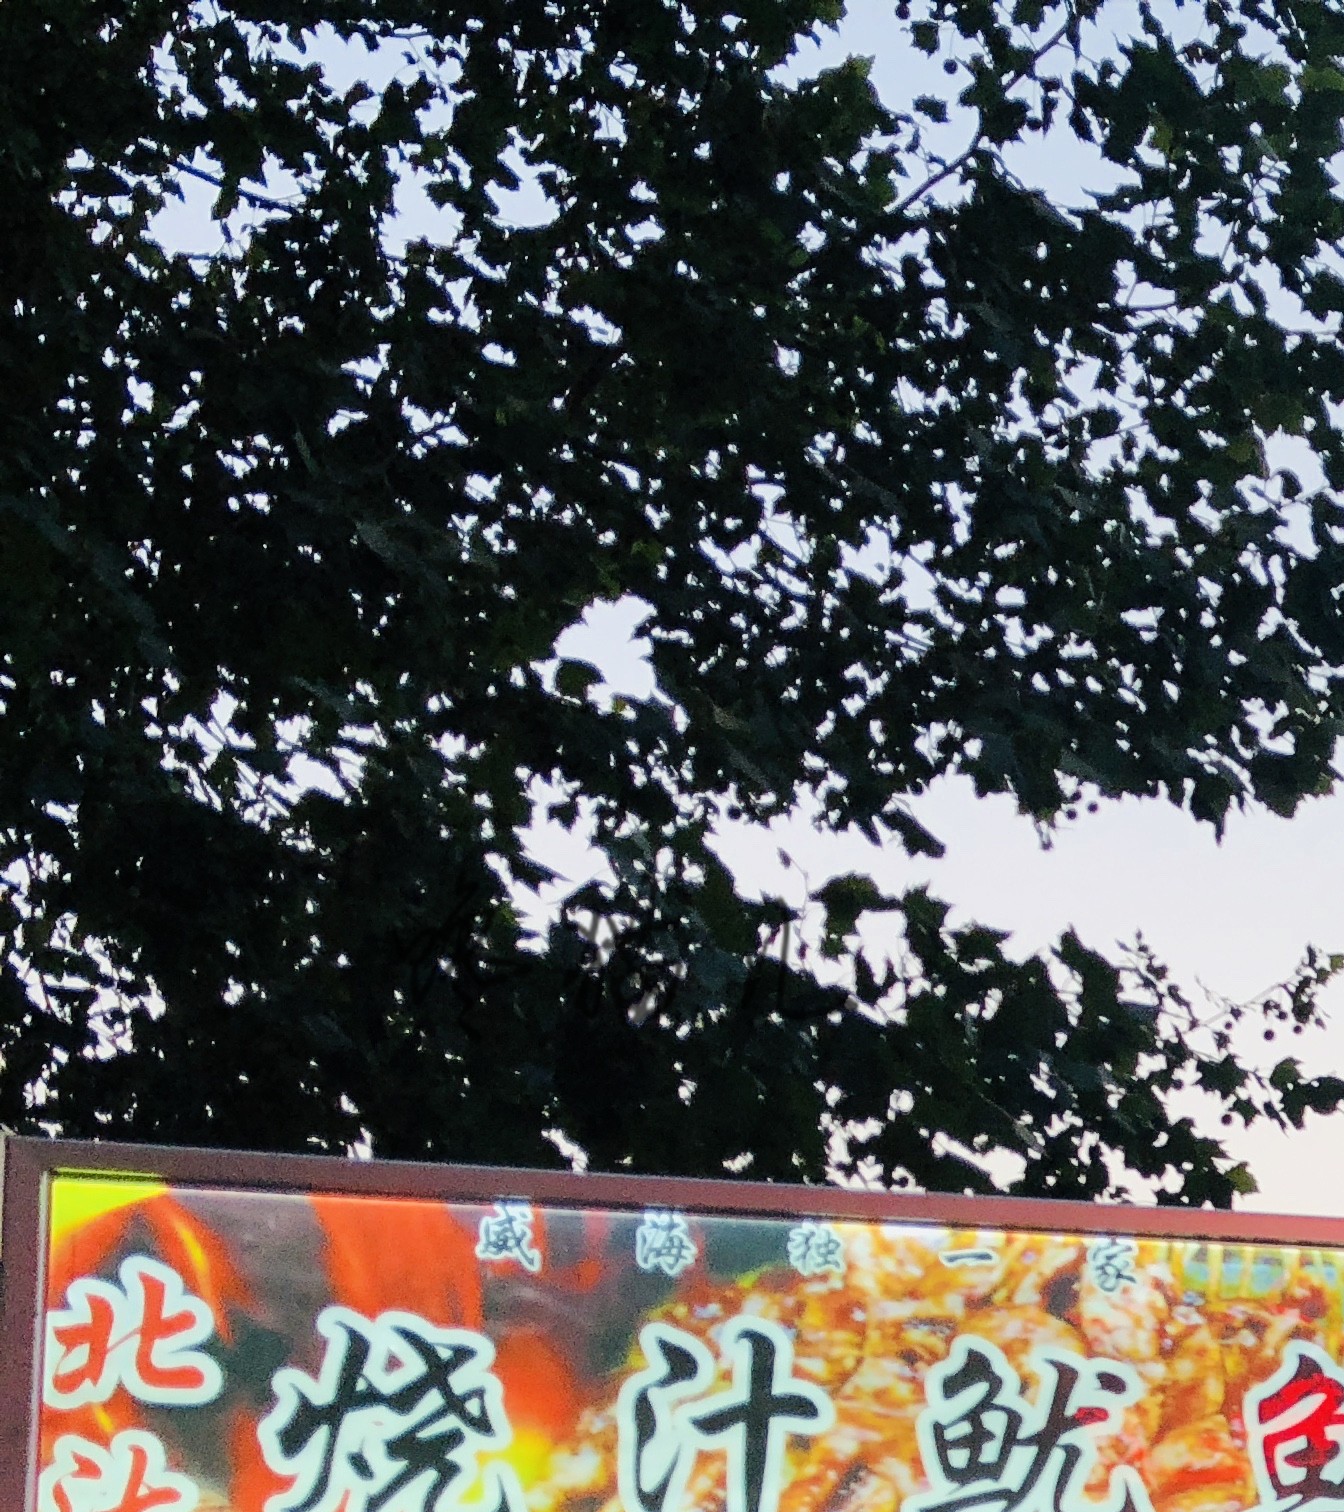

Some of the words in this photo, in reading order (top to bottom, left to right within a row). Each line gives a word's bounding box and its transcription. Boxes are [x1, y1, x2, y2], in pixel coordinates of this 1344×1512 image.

[477, 1195, 1137, 1292] 威海独一家
